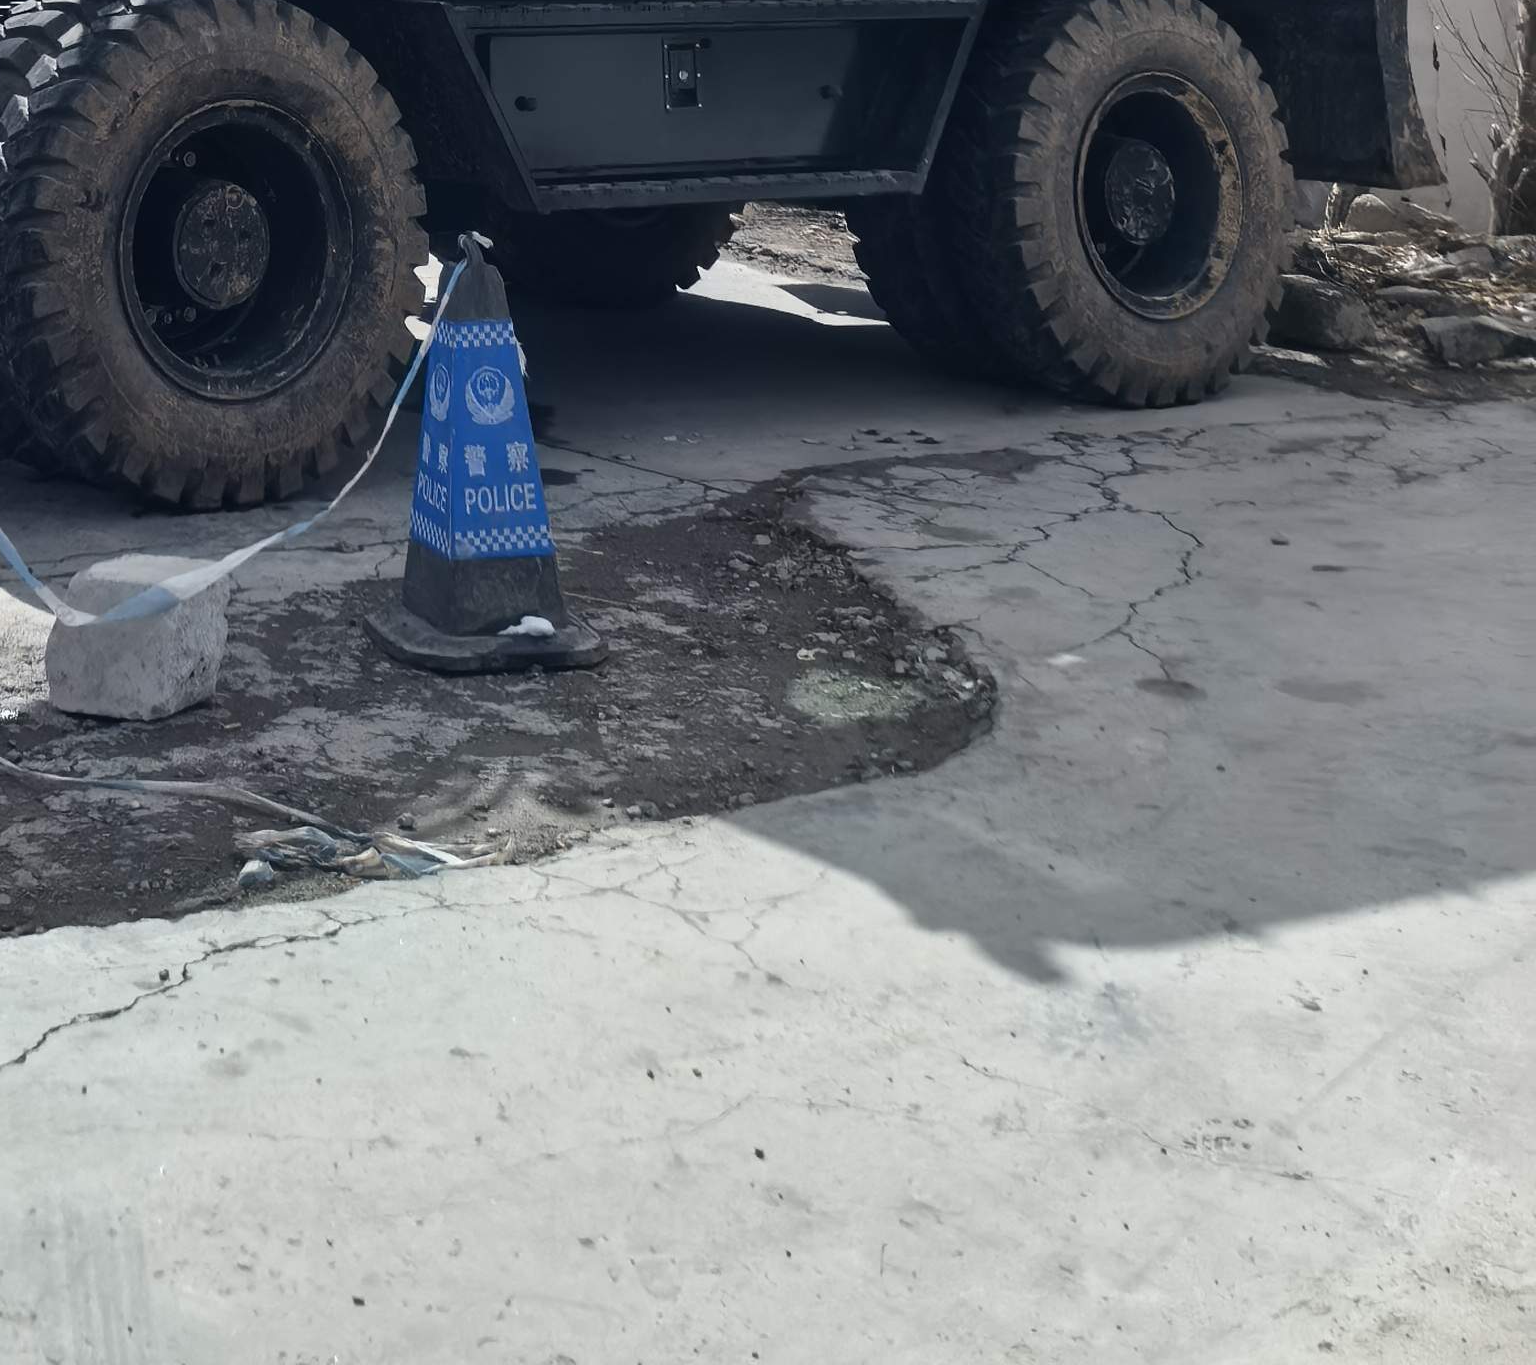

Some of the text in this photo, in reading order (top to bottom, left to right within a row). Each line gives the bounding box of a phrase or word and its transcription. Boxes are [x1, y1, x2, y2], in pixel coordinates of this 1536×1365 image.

[464, 441, 529, 477] 警察
[417, 469, 449, 514] POLICE
[464, 483, 537, 515] POLICE
